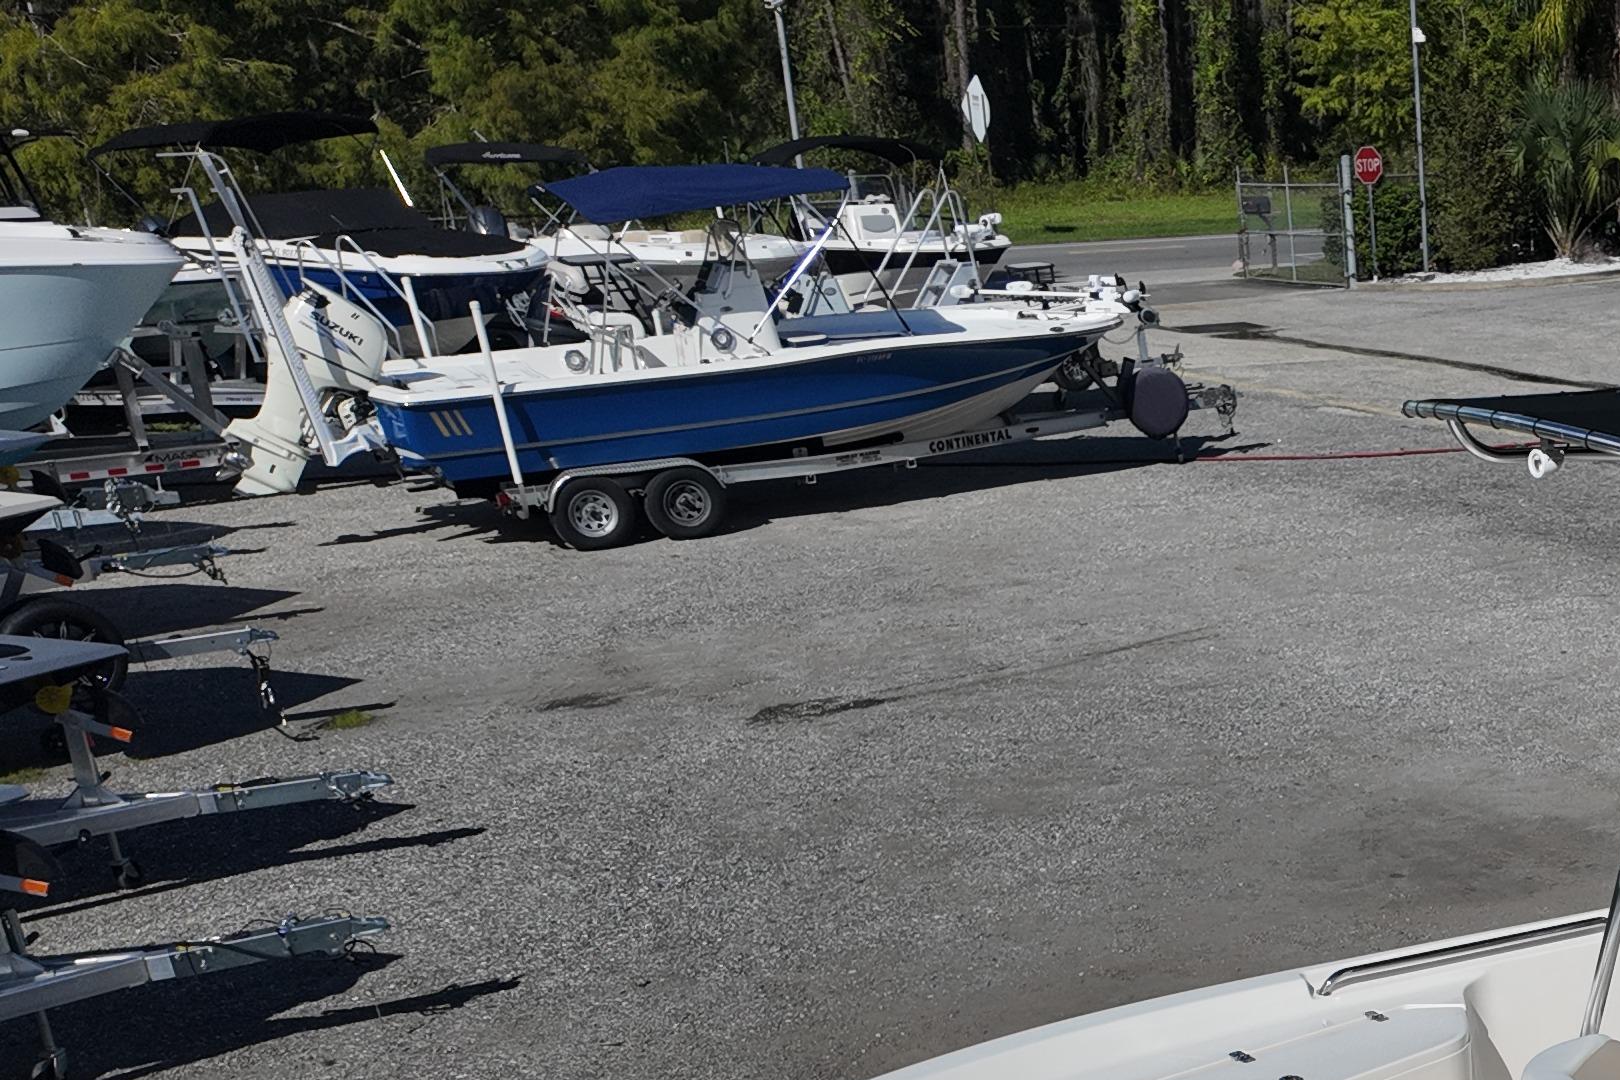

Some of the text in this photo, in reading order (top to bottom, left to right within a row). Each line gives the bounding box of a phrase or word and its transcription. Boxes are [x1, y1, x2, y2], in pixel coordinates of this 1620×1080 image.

[1356, 158, 1380, 172] STOP
[311, 311, 364, 346] SUZUKI
[929, 429, 1012, 453] CONTINENTAL
